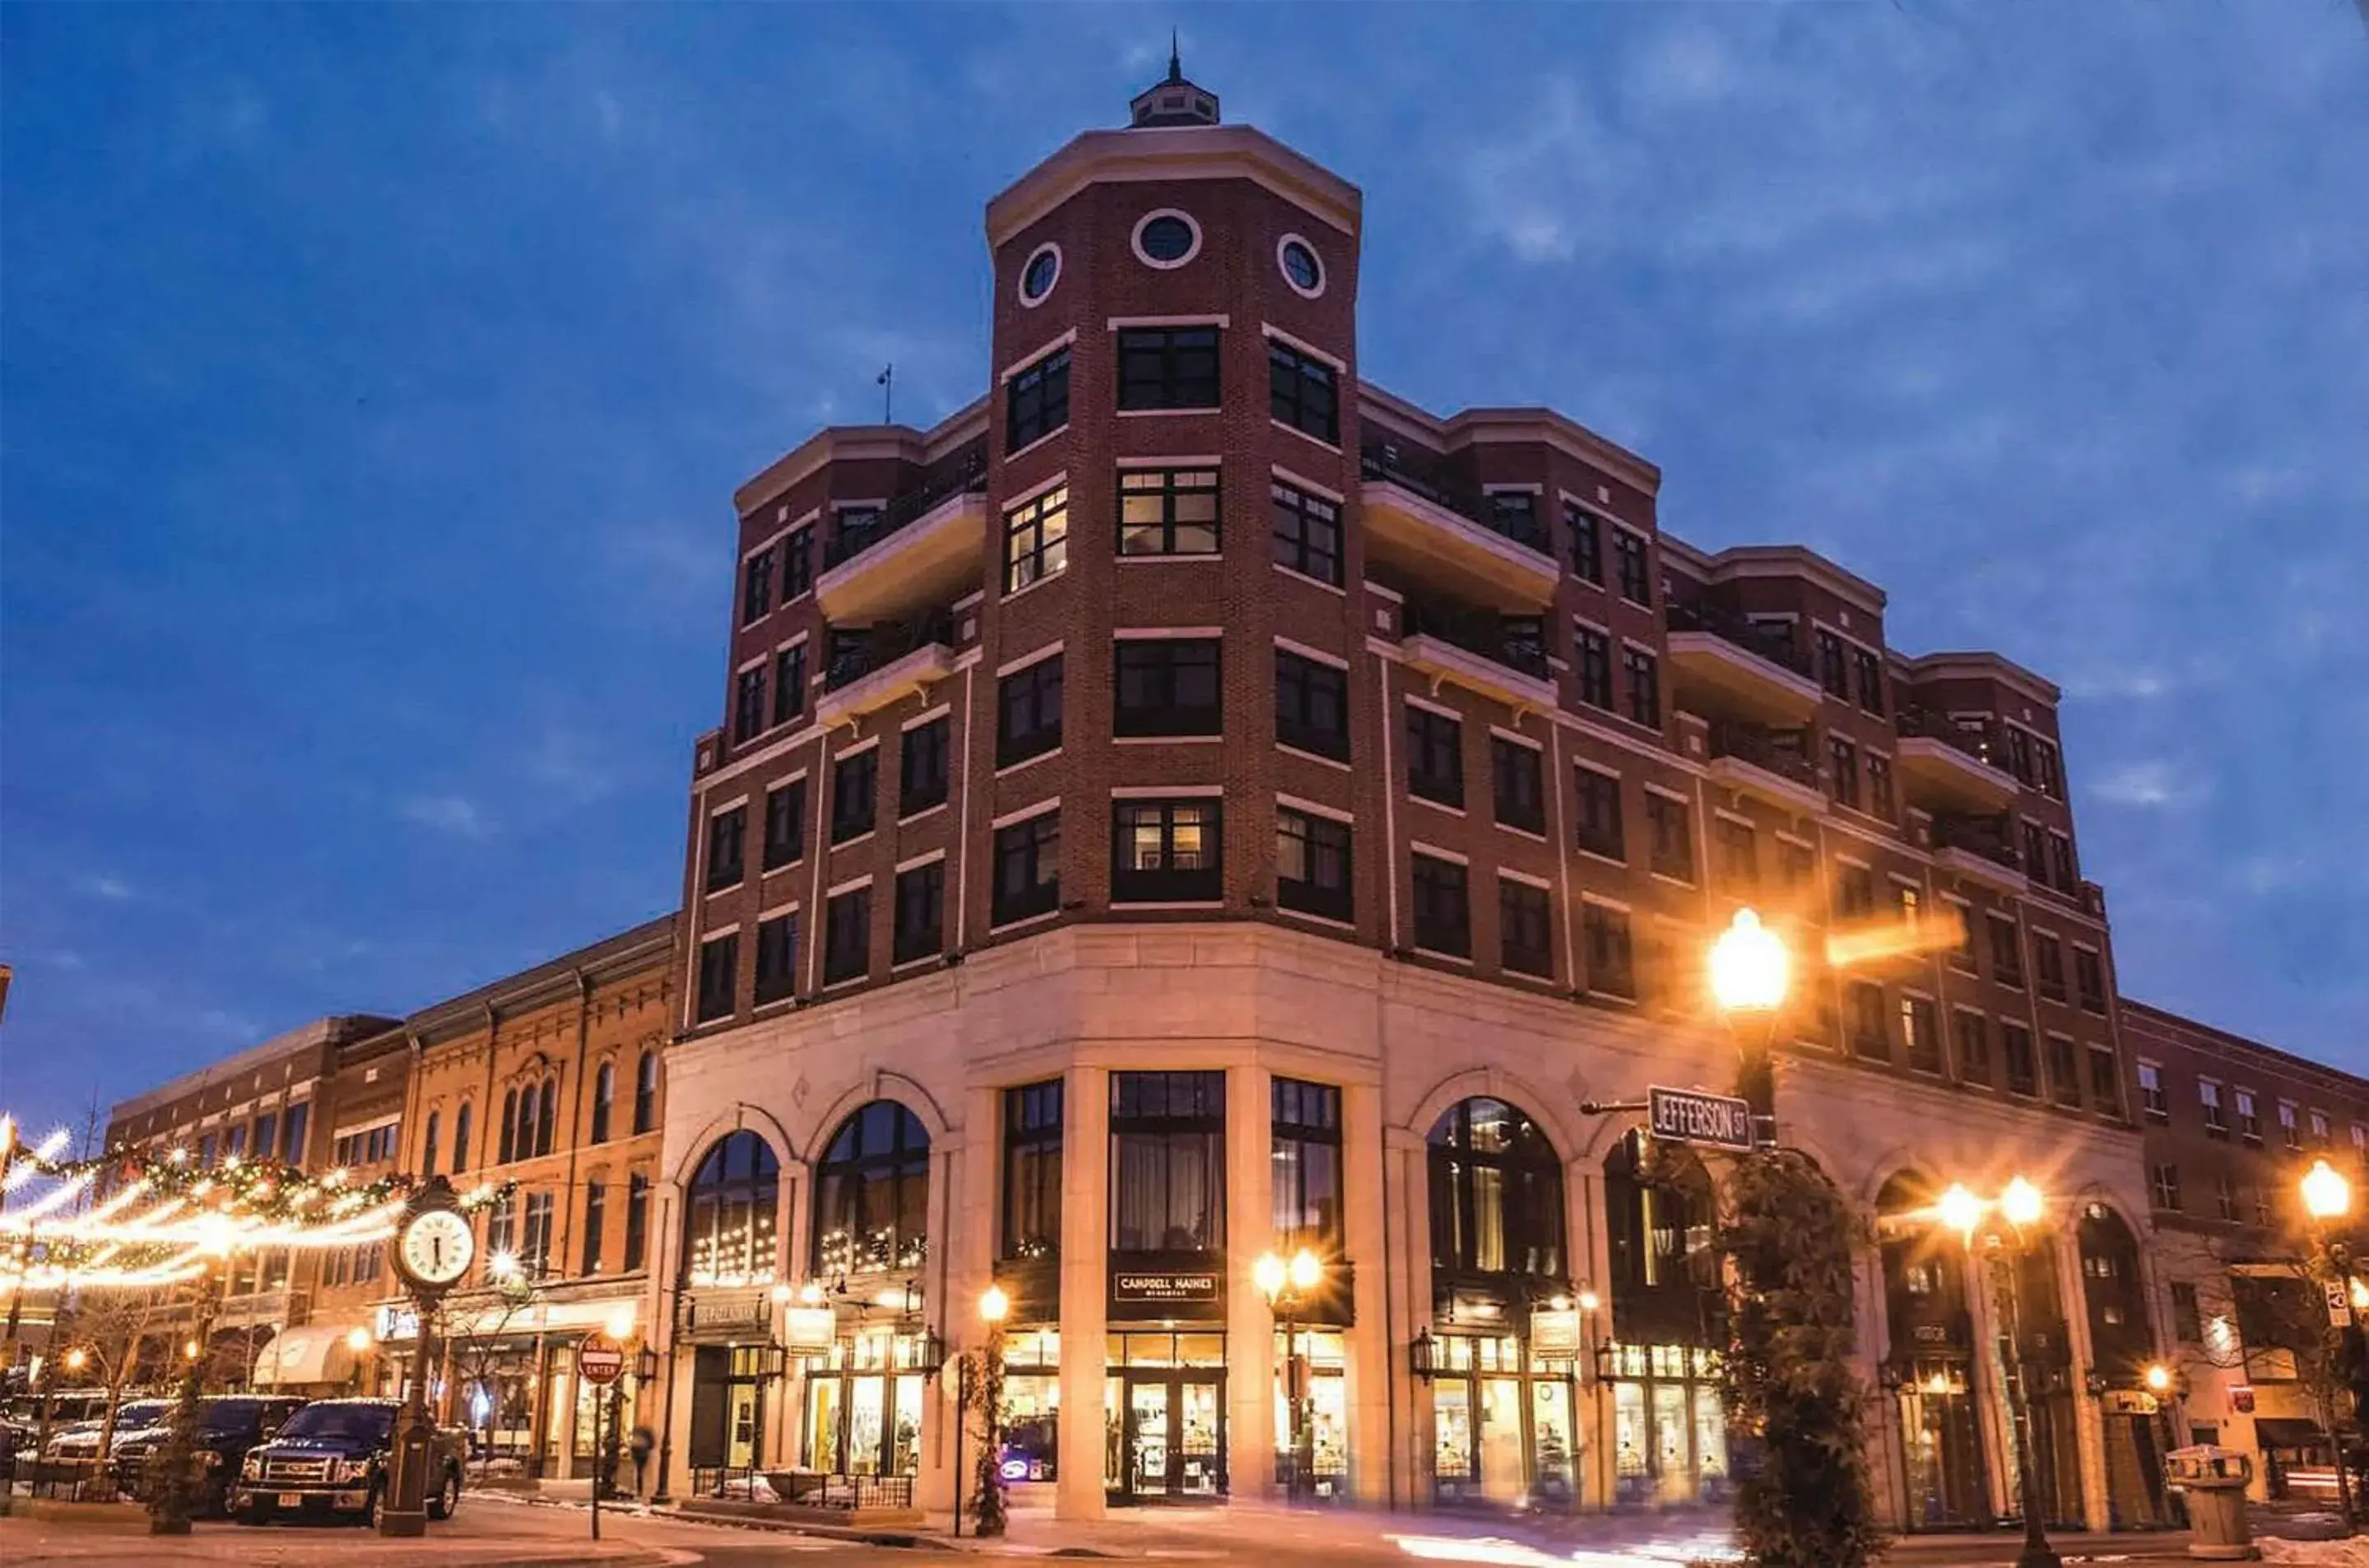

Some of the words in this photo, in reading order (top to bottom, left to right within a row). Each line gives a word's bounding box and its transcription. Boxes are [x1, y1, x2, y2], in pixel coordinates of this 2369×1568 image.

[1655, 1094, 1733, 1139] JEFFERSON
[1733, 1111, 1746, 1134] ST
[586, 1365, 616, 1375] ENTER
